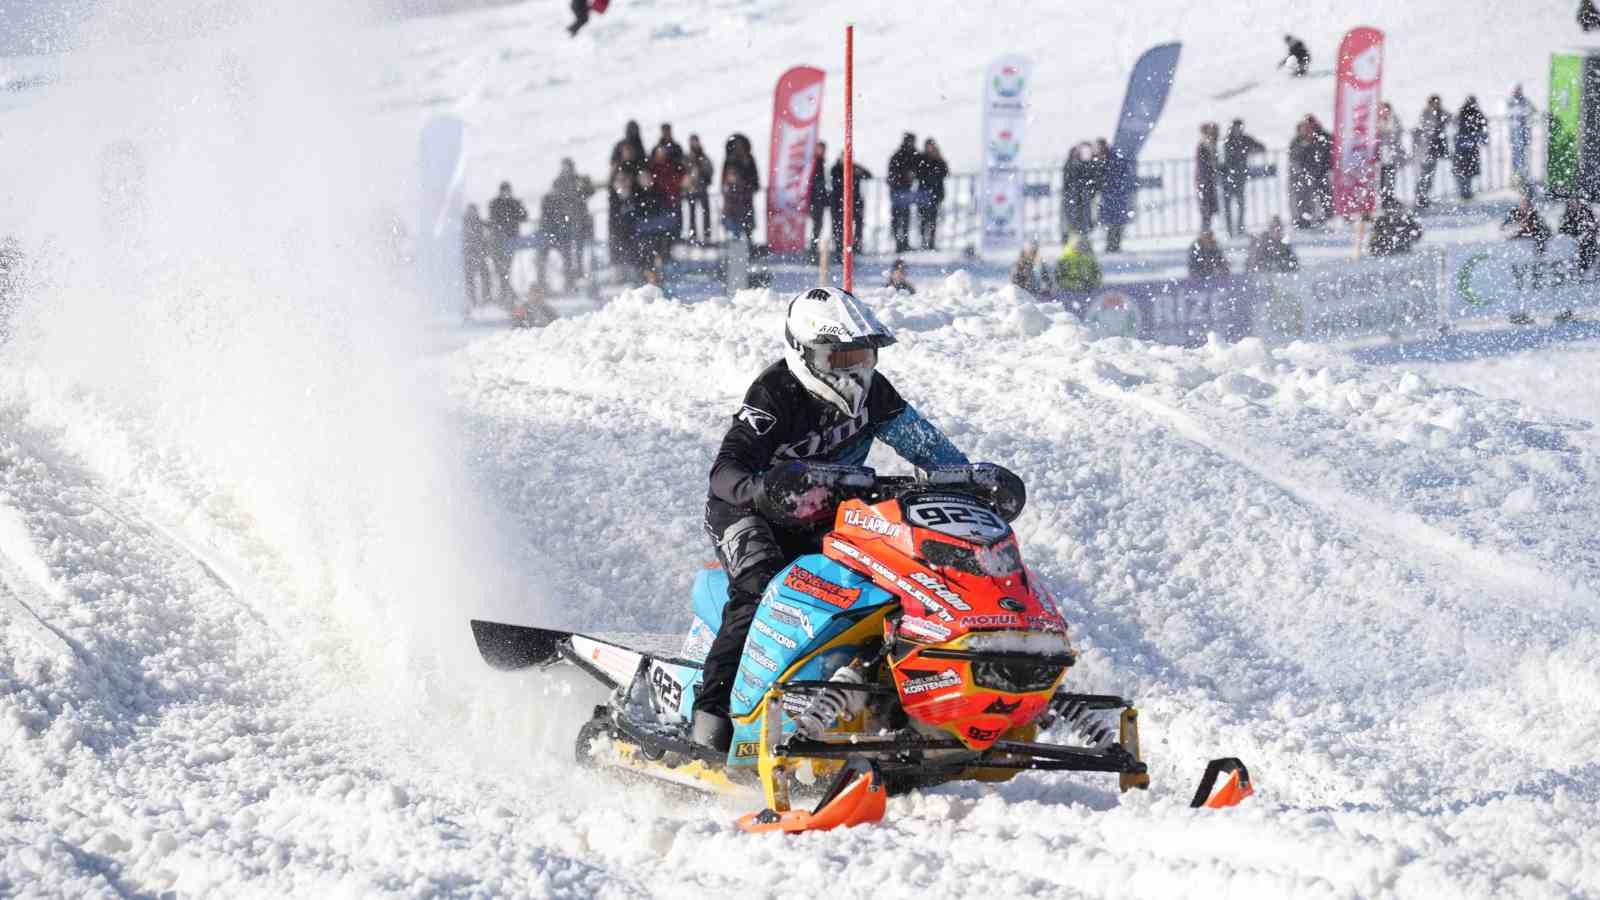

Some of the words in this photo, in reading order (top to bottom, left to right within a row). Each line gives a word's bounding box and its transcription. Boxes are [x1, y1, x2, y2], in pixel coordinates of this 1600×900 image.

[916, 506, 1004, 530] 923
[960, 614, 1018, 628] MOTUL
[652, 665, 682, 713] 923
